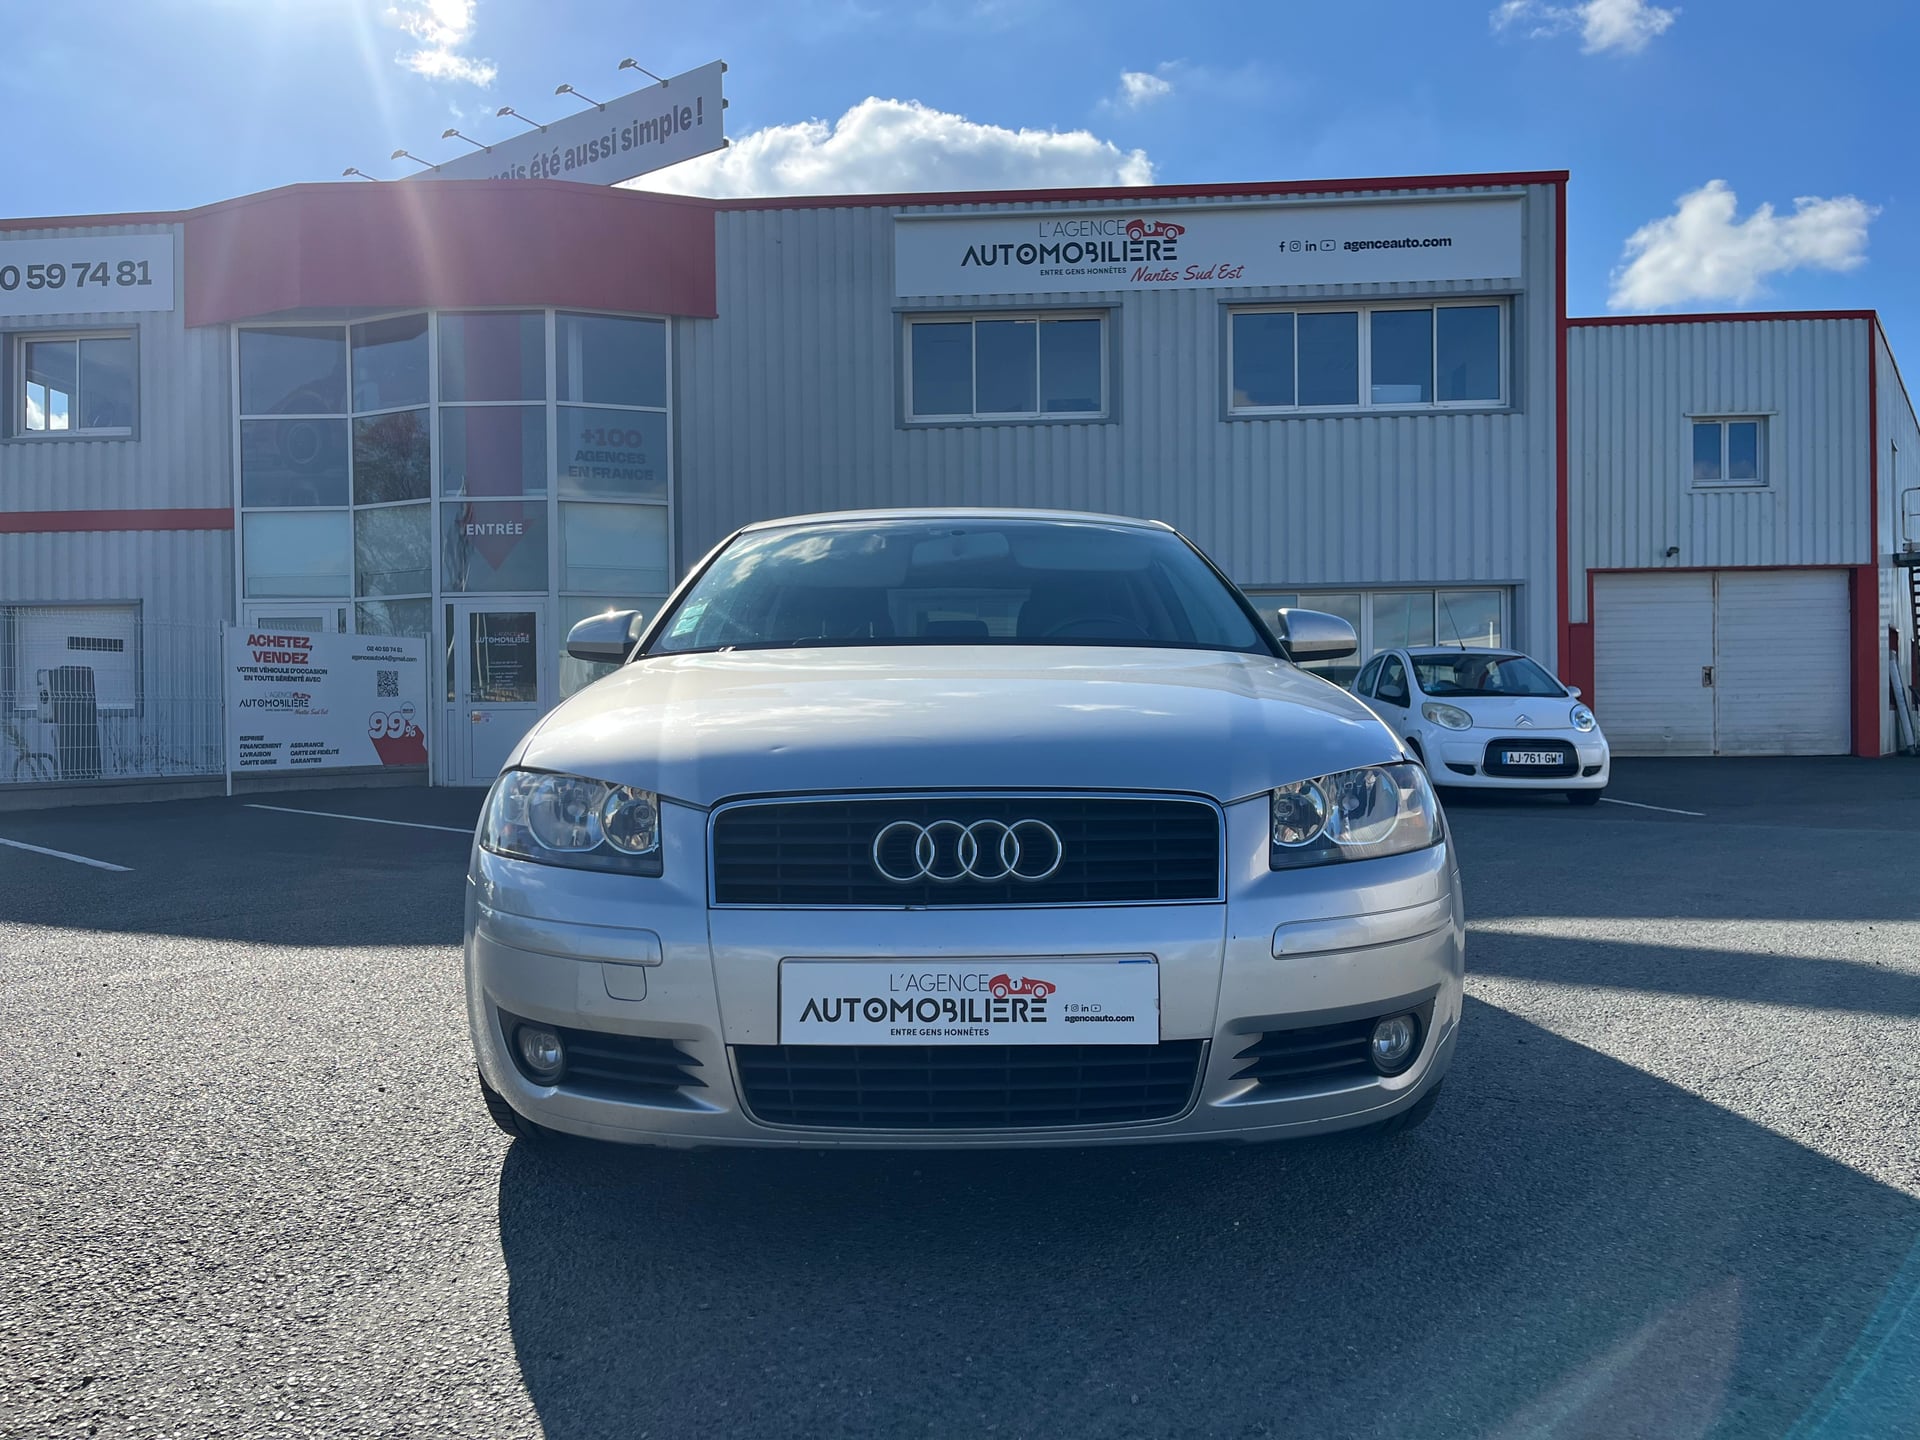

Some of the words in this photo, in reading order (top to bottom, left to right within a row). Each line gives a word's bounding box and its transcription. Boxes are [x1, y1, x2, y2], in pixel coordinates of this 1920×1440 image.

[489, 163, 526, 179] ais
[529, 150, 561, 179] été
[564, 128, 617, 171] aussi
[621, 105, 692, 151] simple
[696, 97, 703, 125] !
[1039, 220, 1126, 238] L'AGENCE
[1343, 237, 1452, 252] agenceauto.com
[26, 263, 66, 289] 59
[72, 261, 110, 287] 74
[116, 260, 152, 286] 81
[1040, 268, 1065, 276] ENTRE
[1066, 267, 1086, 276] GENS
[1087, 265, 1127, 275] HONNÊTES
[1130, 265, 1179, 282] Nantes
[1183, 264, 1217, 281] Sud
[1218, 263, 1245, 279] Est
[581, 428, 642, 448] +100
[575, 450, 646, 465] AGENCES
[568, 465, 589, 478] EN
[592, 467, 655, 480] FRANCE
[466, 520, 523, 535] ENTRÉE
[247, 634, 312, 651] ACHETEZ,
[252, 651, 308, 664] VENDEZ
[259, 666, 289, 674] VÉHICULE
[290, 667, 327, 675] D'OCCASION
[890, 973, 989, 992] L'AGENCE
[1064, 1014, 1135, 1024] agenceauto.com
[890, 1028, 917, 1036] ENTRE
[919, 1028, 943, 1036] GENS
[944, 1026, 990, 1036] HONNÊTES
